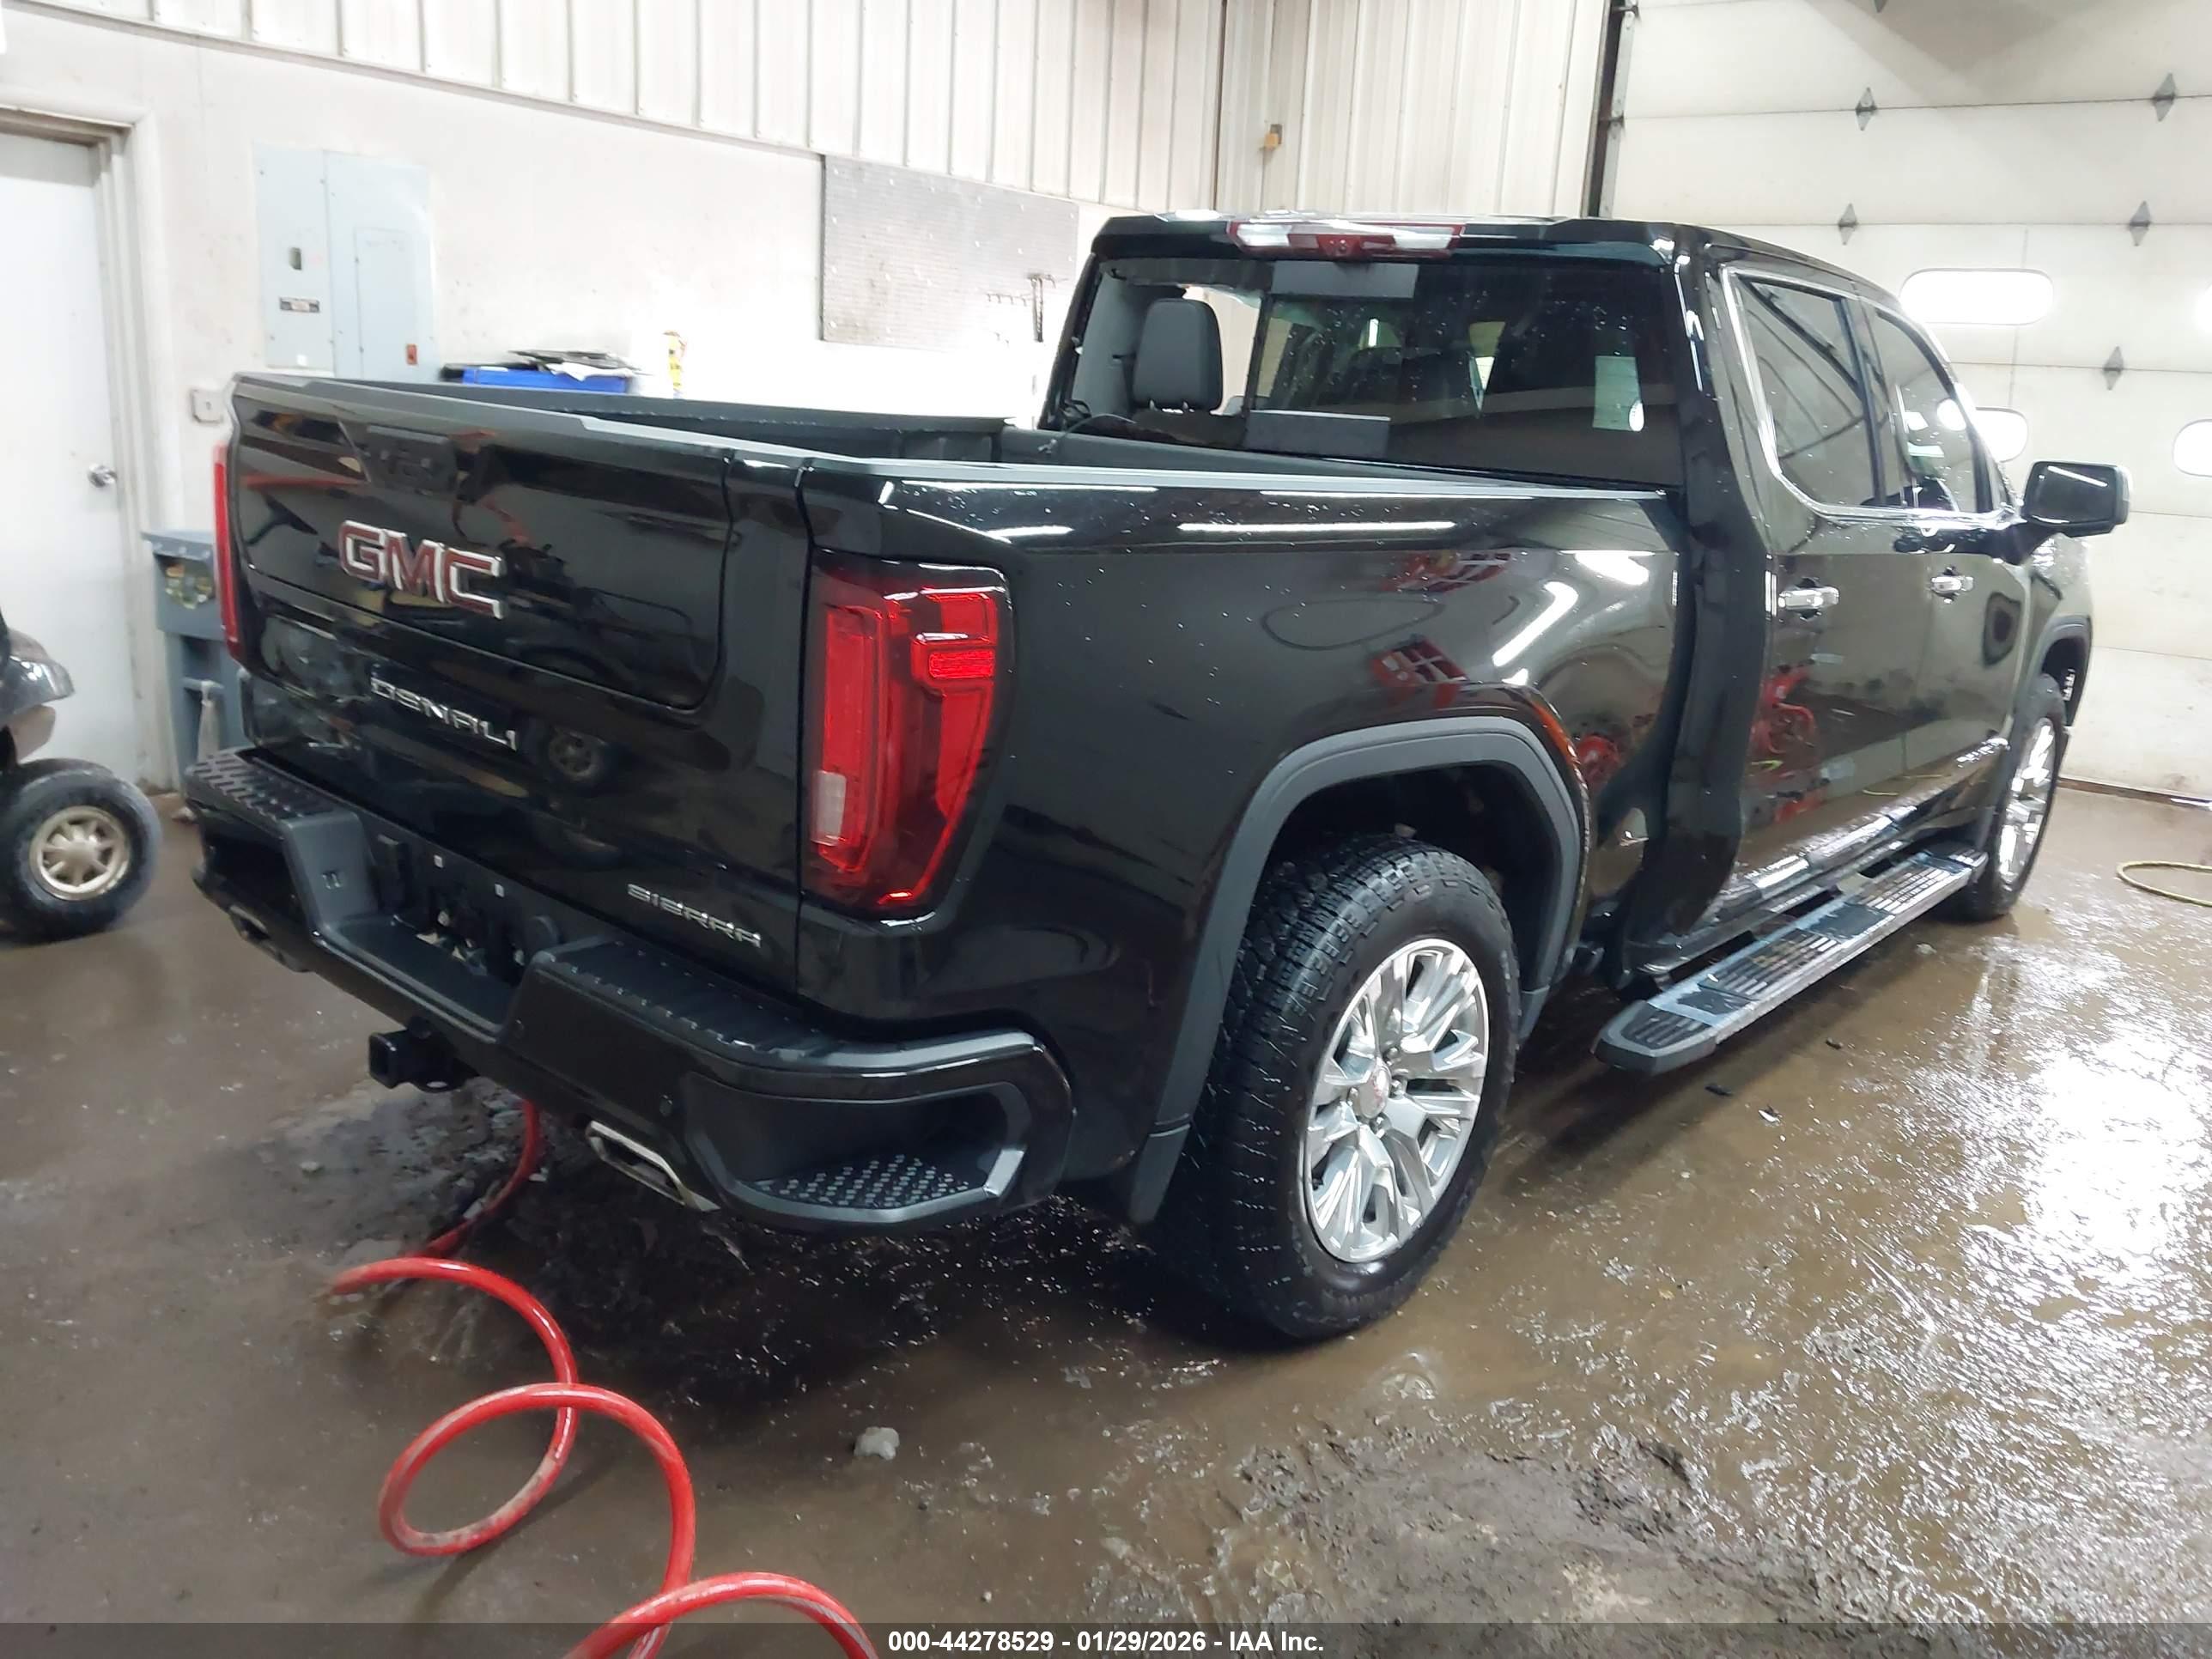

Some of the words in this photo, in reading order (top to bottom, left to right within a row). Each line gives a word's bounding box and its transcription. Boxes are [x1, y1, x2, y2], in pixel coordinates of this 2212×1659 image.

[338, 520, 503, 619] GMC
[370, 677, 517, 751] DENALI
[627, 884, 762, 948] SIERRA
